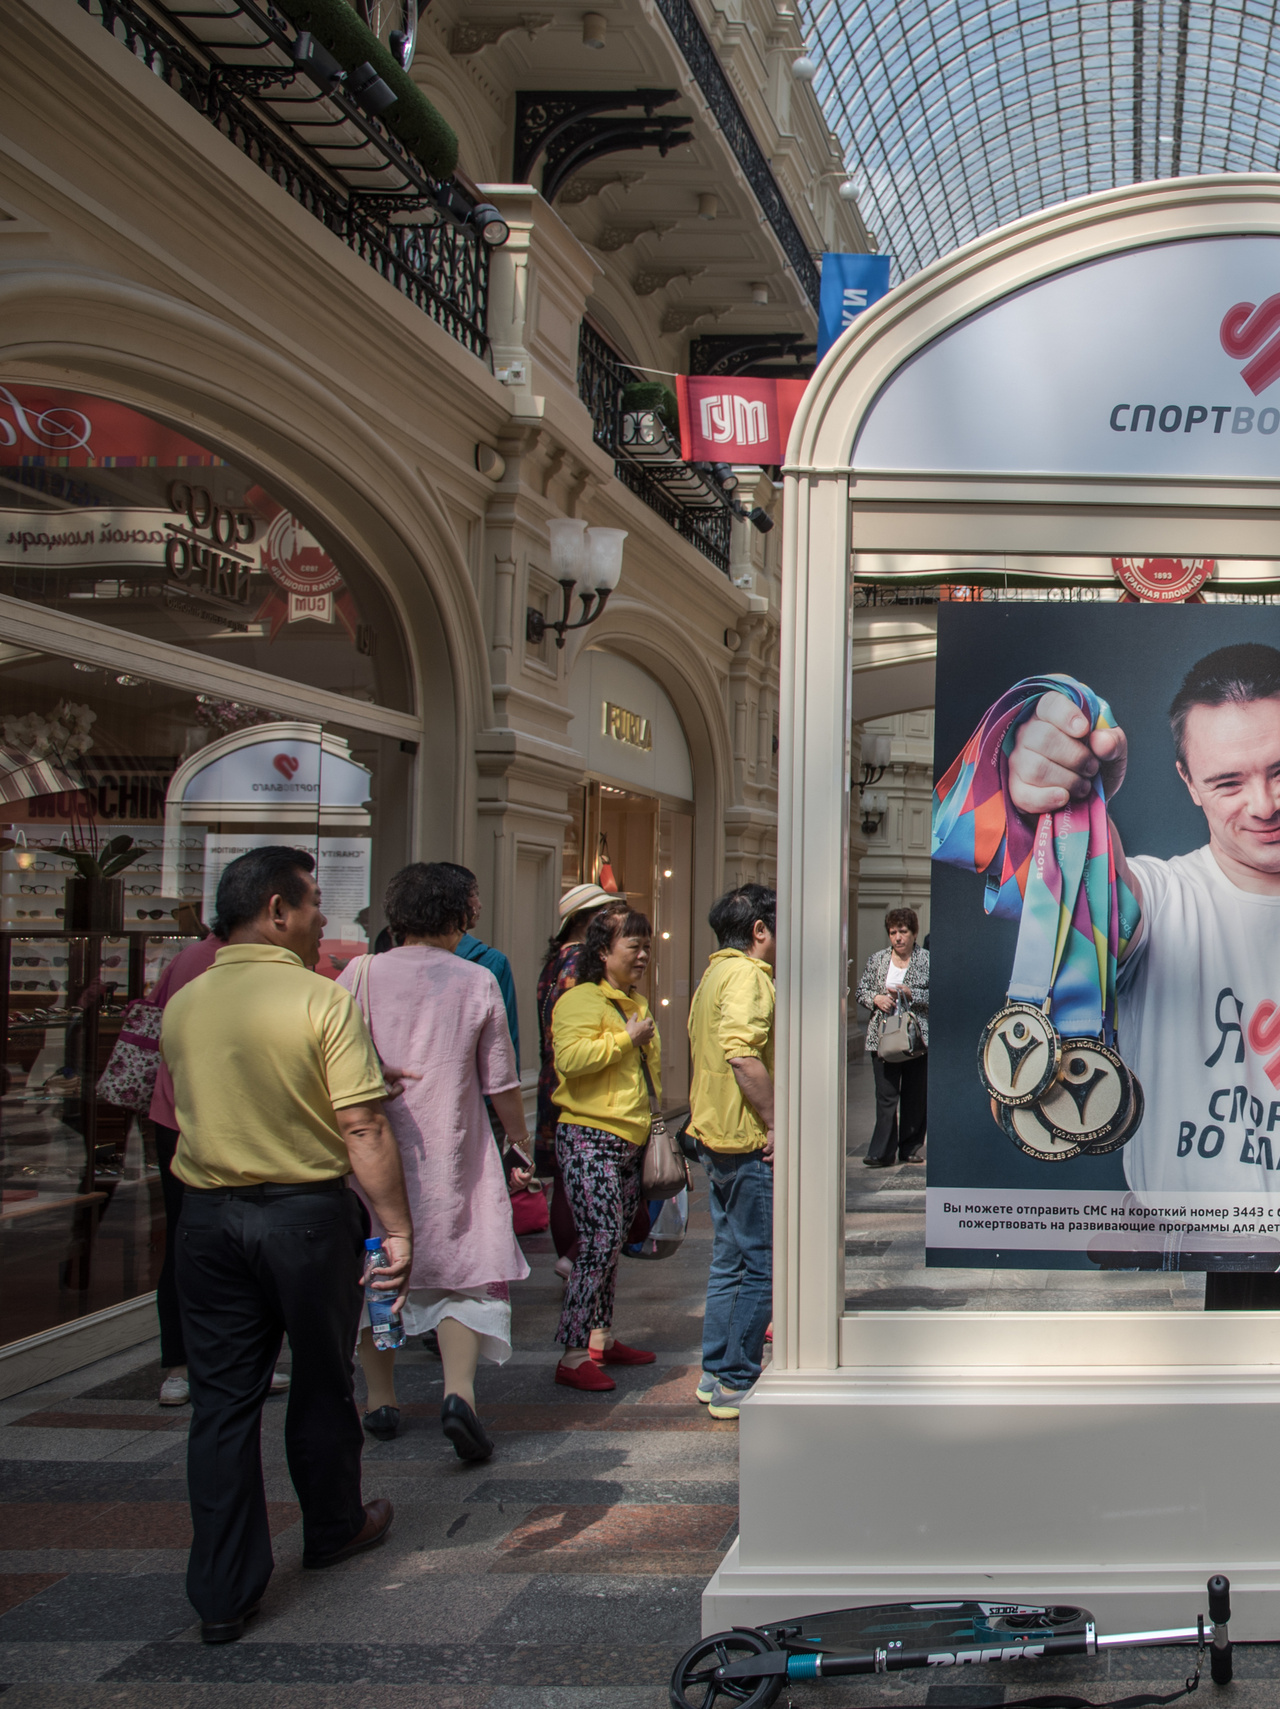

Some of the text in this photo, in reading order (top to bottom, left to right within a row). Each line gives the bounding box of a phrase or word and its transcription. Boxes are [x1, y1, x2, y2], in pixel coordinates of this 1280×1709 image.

[699, 394, 769, 446] ГУМ
[1153, 572, 1173, 580] 1893
[1123, 571, 1203, 600] КРАСНАЯ ПЛОЩАДЬ
[1036, 852, 1045, 880] 2015
[1204, 987, 1246, 1068] Я
[1052, 1128, 1067, 1139] LOS
[1177, 1121, 1225, 1159] ВО
[1022, 1145, 1036, 1157] LOS
[944, 1203, 961, 1212] Вы
[965, 1206, 1012, 1214] можете
[1017, 1207, 1079, 1216] отправить
[1084, 1206, 1107, 1215] СМС
[1129, 1207, 1186, 1218] короткий
[1191, 1209, 1228, 1219] номер
[1233, 1207, 1263, 1217] 3443
[1268, 1209, 1273, 1217] с
[959, 1220, 1047, 1231] пожертвовать
[1069, 1223, 1155, 1232] развивающие
[1159, 1224, 1229, 1234] программы
[1233, 1224, 1254, 1233] для
[989, 1605, 1018, 1615] ROCES
